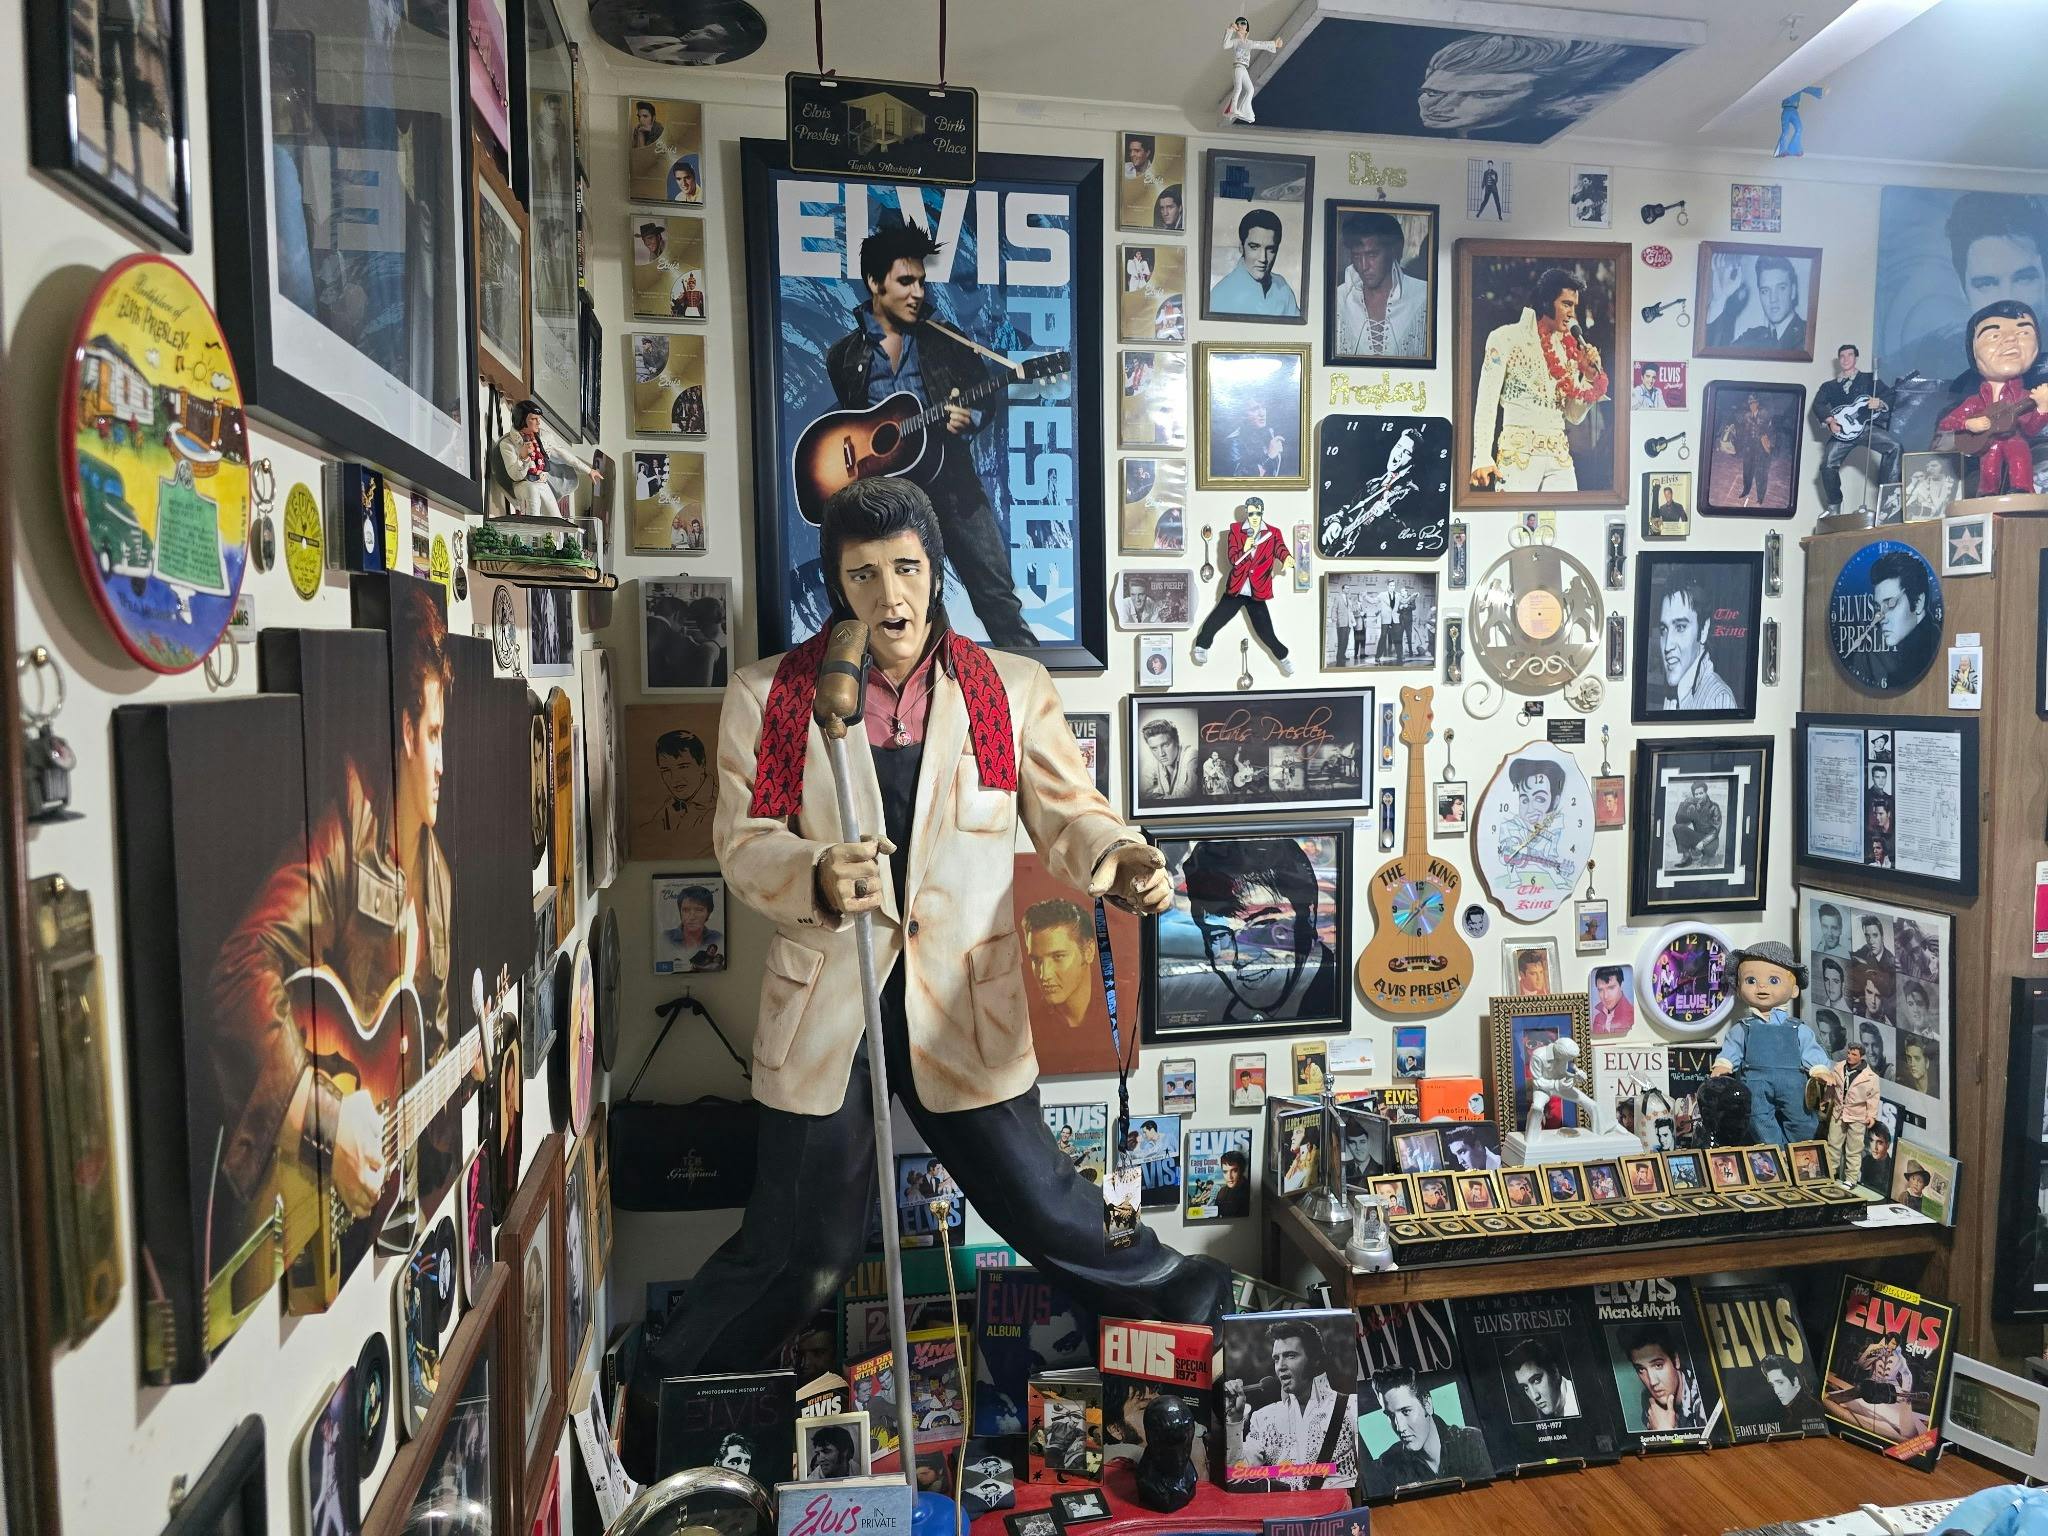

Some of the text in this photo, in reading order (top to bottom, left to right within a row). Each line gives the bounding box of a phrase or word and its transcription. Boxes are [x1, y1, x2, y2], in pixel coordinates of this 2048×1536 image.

[802, 103, 831, 119] Elvis
[934, 116, 967, 133] Birth
[933, 138, 967, 155] Place
[777, 179, 1071, 287] ELVIS
[656, 257, 680, 270] Elvis
[1647, 248, 1673, 266] Elvis
[658, 374, 681, 387] Elvis
[1659, 367, 1681, 382] ELVIS
[1346, 422, 1358, 431] 11
[1381, 422, 1393, 431] 12
[1420, 424, 1427, 433] 1
[1326, 446, 1339, 456] 10
[1439, 449, 1447, 458] 2
[1324, 481, 1331, 490] 9
[1661, 474, 1679, 485] Elvis
[1438, 483, 1446, 492] 3
[1380, 541, 1387, 550] 6
[1415, 541, 1424, 551] 5
[1878, 541, 1889, 554] 12
[1714, 608, 1739, 620] The
[1839, 593, 1875, 623] ELVIS
[1935, 607, 1942, 622] 3
[1881, 677, 1888, 689] 6
[1201, 706, 1334, 760] Elvis Presley
[1378, 863, 1406, 887] THE
[1428, 860, 1459, 889] KING
[1516, 884, 1544, 895] The
[1392, 905, 1398, 914] 9
[1439, 903, 1445, 912] 3
[1516, 899, 1554, 911] King
[1416, 927, 1422, 937] 6
[1374, 974, 1462, 997] ELVIS PRESLEY
[1675, 993, 1708, 1010] ELVIS
[1604, 1052, 1662, 1071] ELVIS
[1668, 1051, 1714, 1071] ELVI
[1385, 1089, 1418, 1105] ELVIS
[1044, 1106, 1106, 1128] ELVIS
[1438, 1107, 1469, 1116] shooting
[1190, 1130, 1250, 1155] ELVIS
[1191, 1159, 1203, 1168] Easy
[901, 1198, 962, 1235] ELVS
[989, 1273, 1003, 1282] THE
[1594, 1277, 1678, 1305] ELVIS
[1854, 1283, 1870, 1296] the
[987, 1284, 1051, 1326] ELVIS
[1474, 1308, 1574, 1335] ELVIS PRESLEY
[1845, 1297, 1942, 1350] ELVIS
[987, 1325, 1021, 1338] ALBUM
[1706, 1298, 1804, 1369] ELVIS
[1105, 1324, 1176, 1379] ELVIS
[1905, 1340, 1934, 1360] story
[854, 1359, 895, 1381] WITH ELV
[856, 1360, 874, 1374] SUN
[1175, 1358, 1209, 1374] SPECIAL
[1175, 1371, 1197, 1382] 1973
[702, 1387, 738, 1396] PHOTOGRAPHIC
[739, 1386, 758, 1394] HISTORY
[684, 1393, 780, 1434] ELVIS
[801, 1396, 842, 1418] ELVIS
[1741, 1424, 1758, 1437] DAVE
[1759, 1421, 1780, 1435] MARSH
[1231, 1460, 1331, 1479] Elvis Presley
[789, 1493, 863, 1536] Elvis
[874, 1507, 885, 1517] IN
[861, 1518, 897, 1529] PRIVATE
